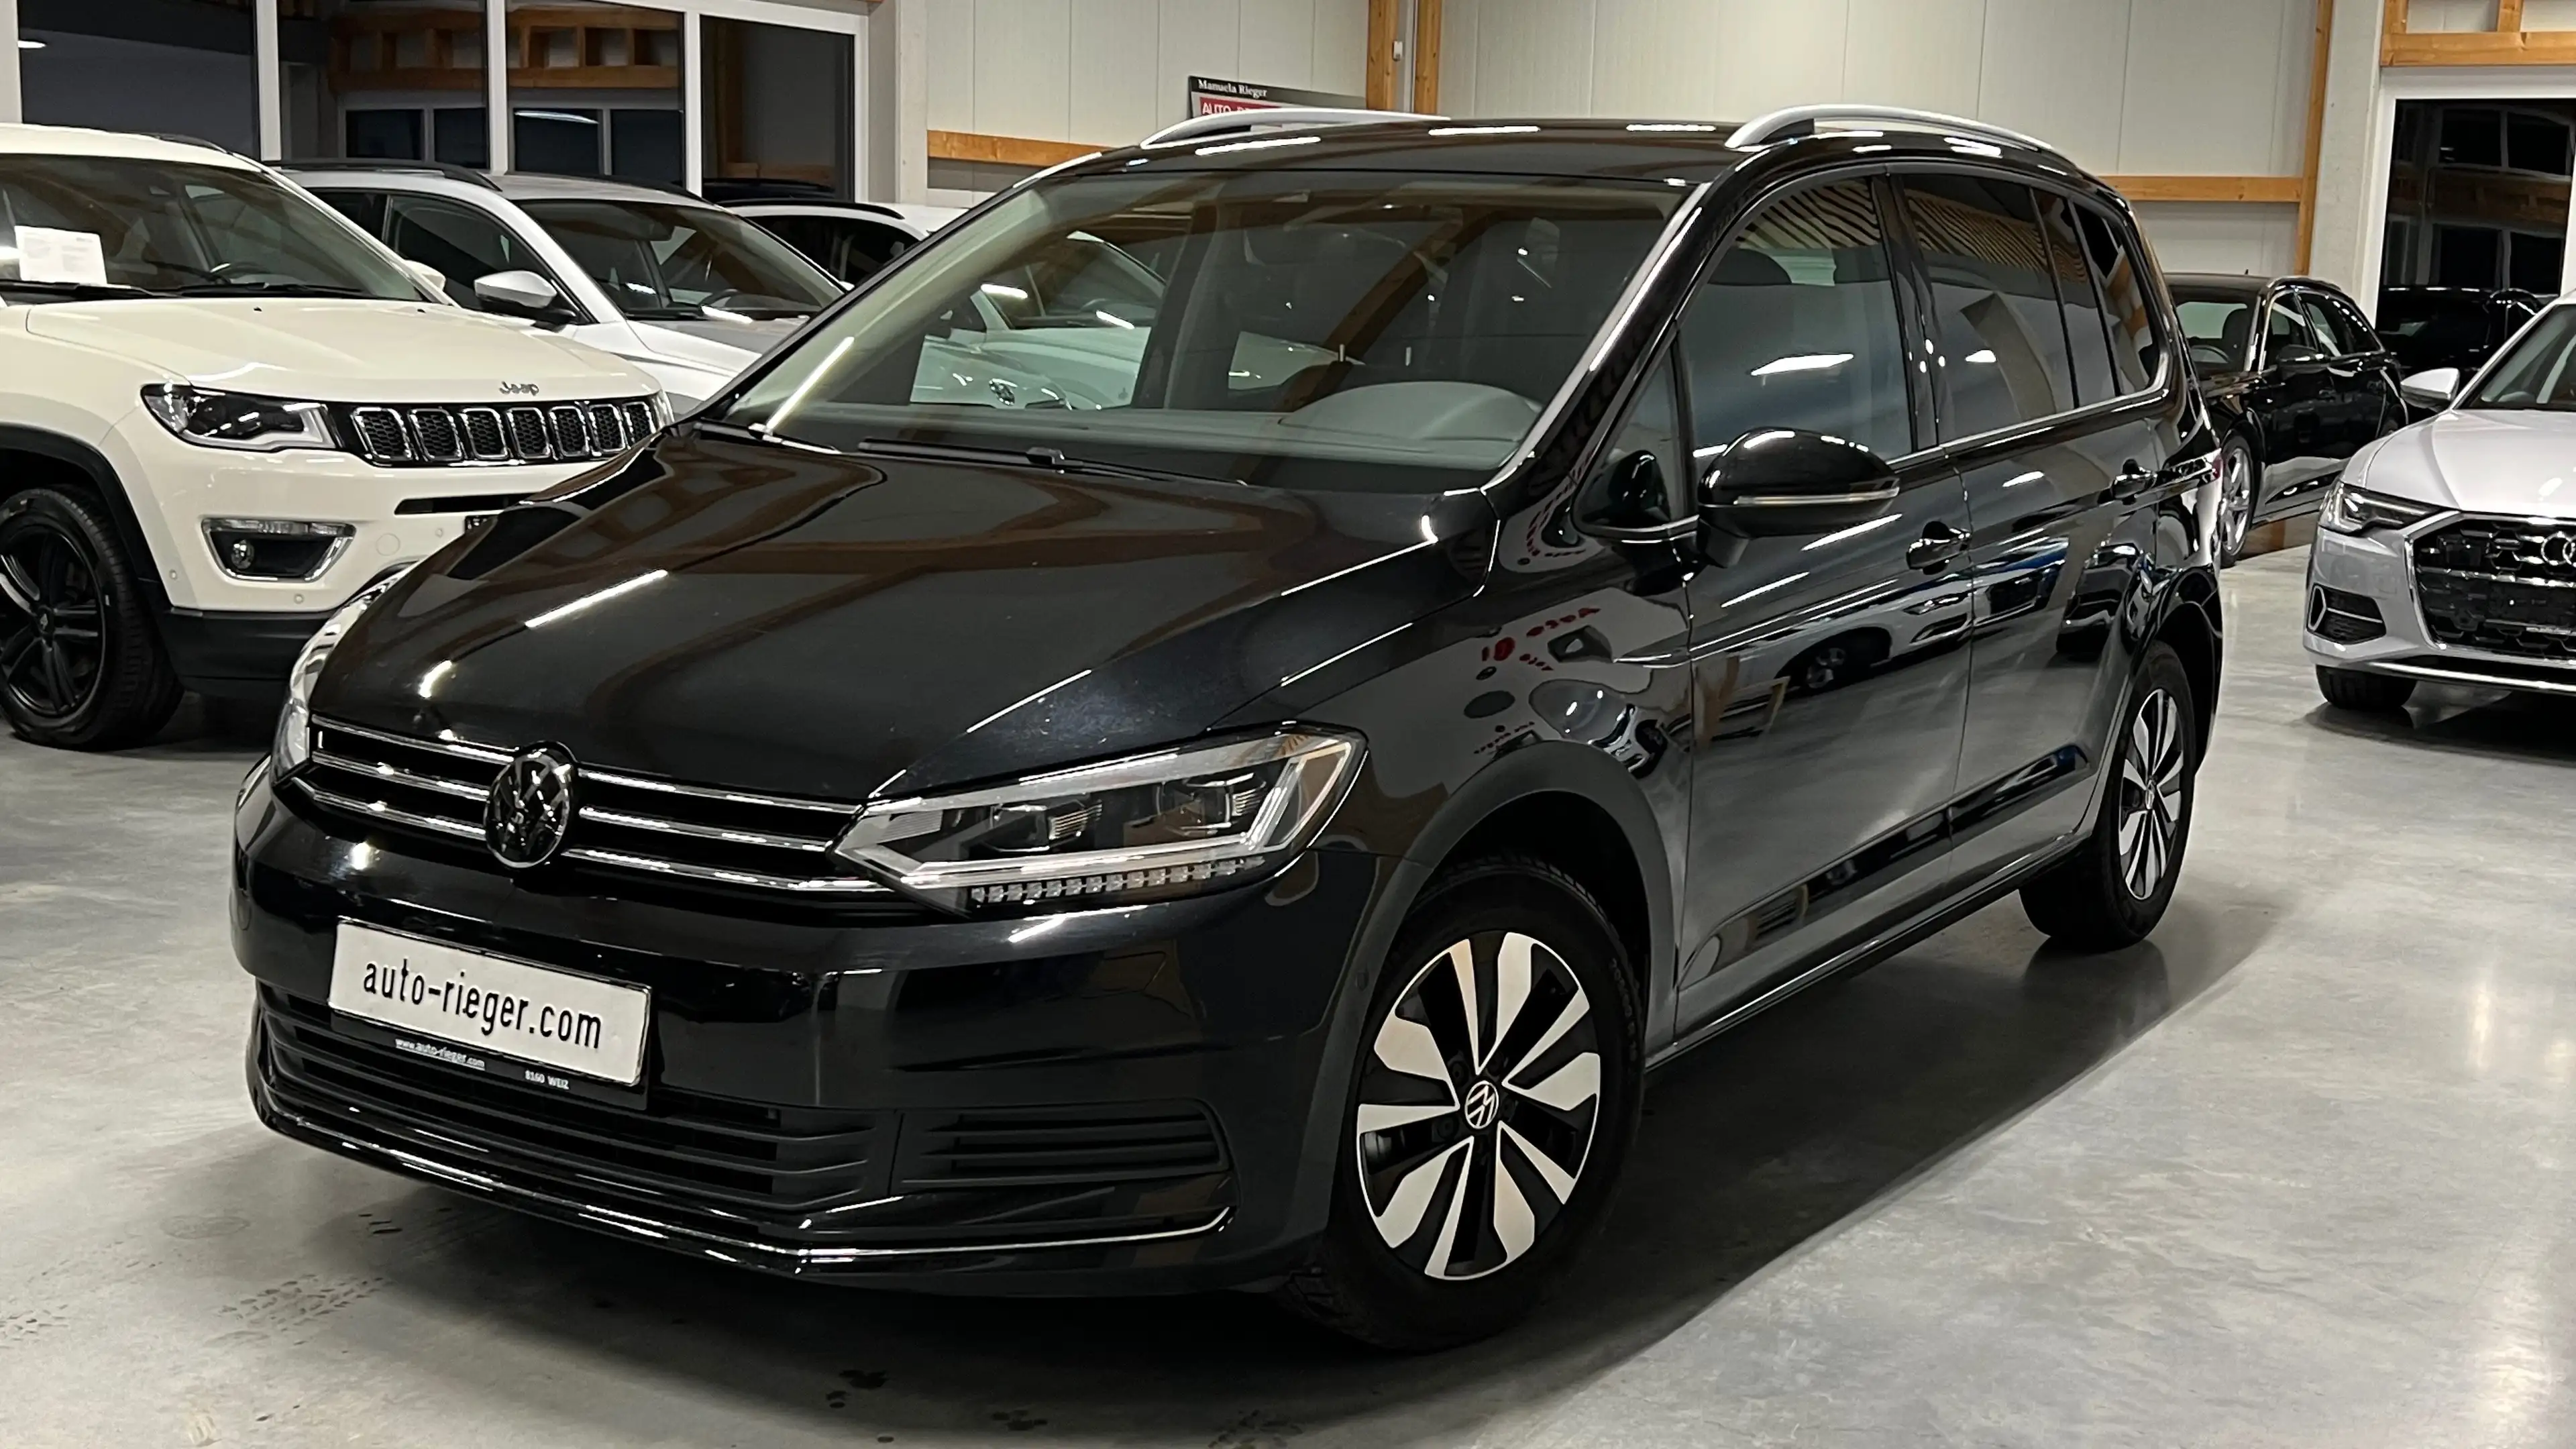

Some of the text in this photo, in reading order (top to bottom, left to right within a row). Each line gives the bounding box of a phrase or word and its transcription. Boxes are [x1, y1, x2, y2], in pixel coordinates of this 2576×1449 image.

[1198, 79, 1267, 99] Manuela Rieger
[499, 380, 539, 396] Jeep
[364, 958, 601, 1049] auto-rieger.com
[395, 1038, 484, 1070] www.auto-rieger.com
